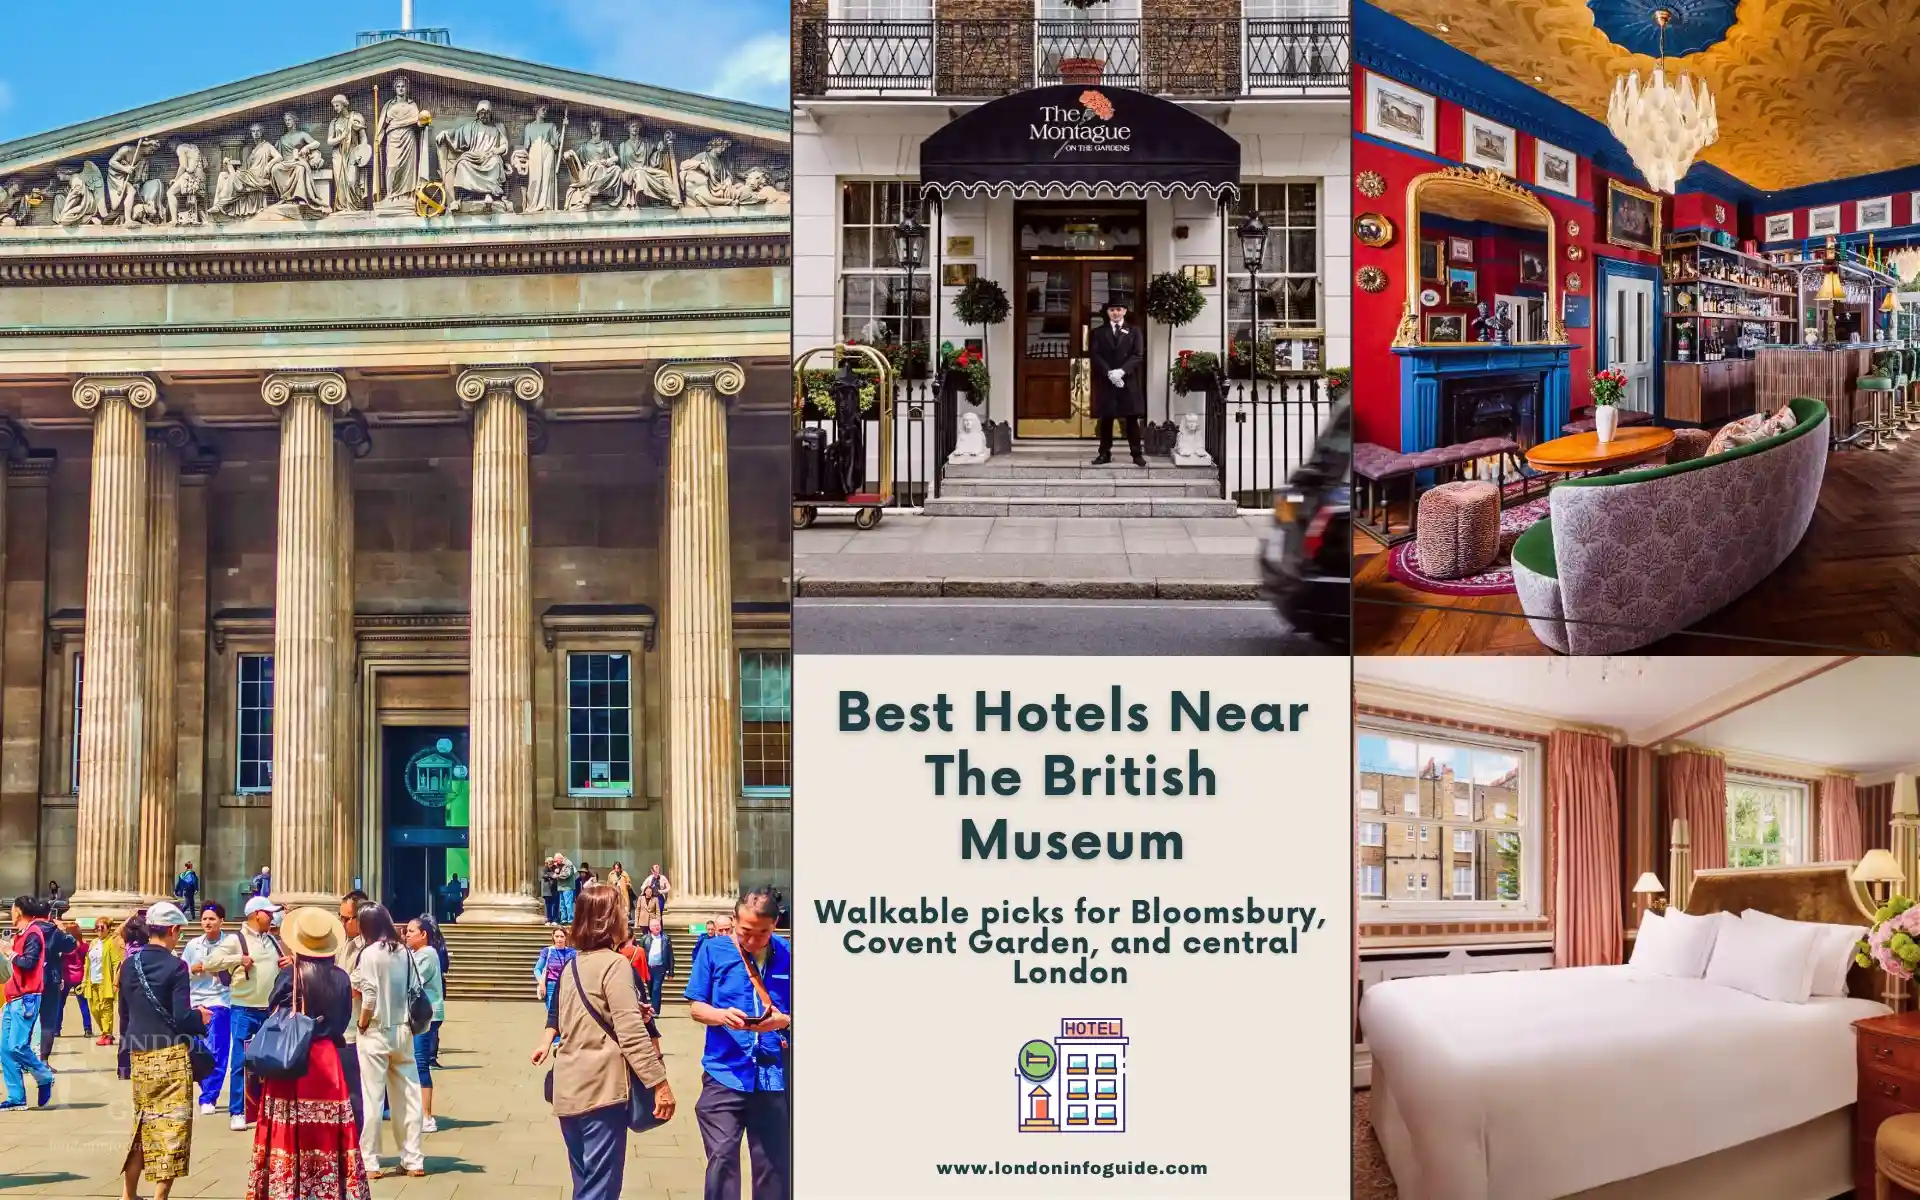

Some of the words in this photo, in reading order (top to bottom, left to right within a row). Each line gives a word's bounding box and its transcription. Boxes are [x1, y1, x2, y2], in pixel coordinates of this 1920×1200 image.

[1040, 105, 1080, 122] The
[1029, 124, 1131, 144] Montague
[1066, 144, 1077, 152] ON
[1078, 144, 1093, 152] THE
[1094, 144, 1130, 152] GARDENS
